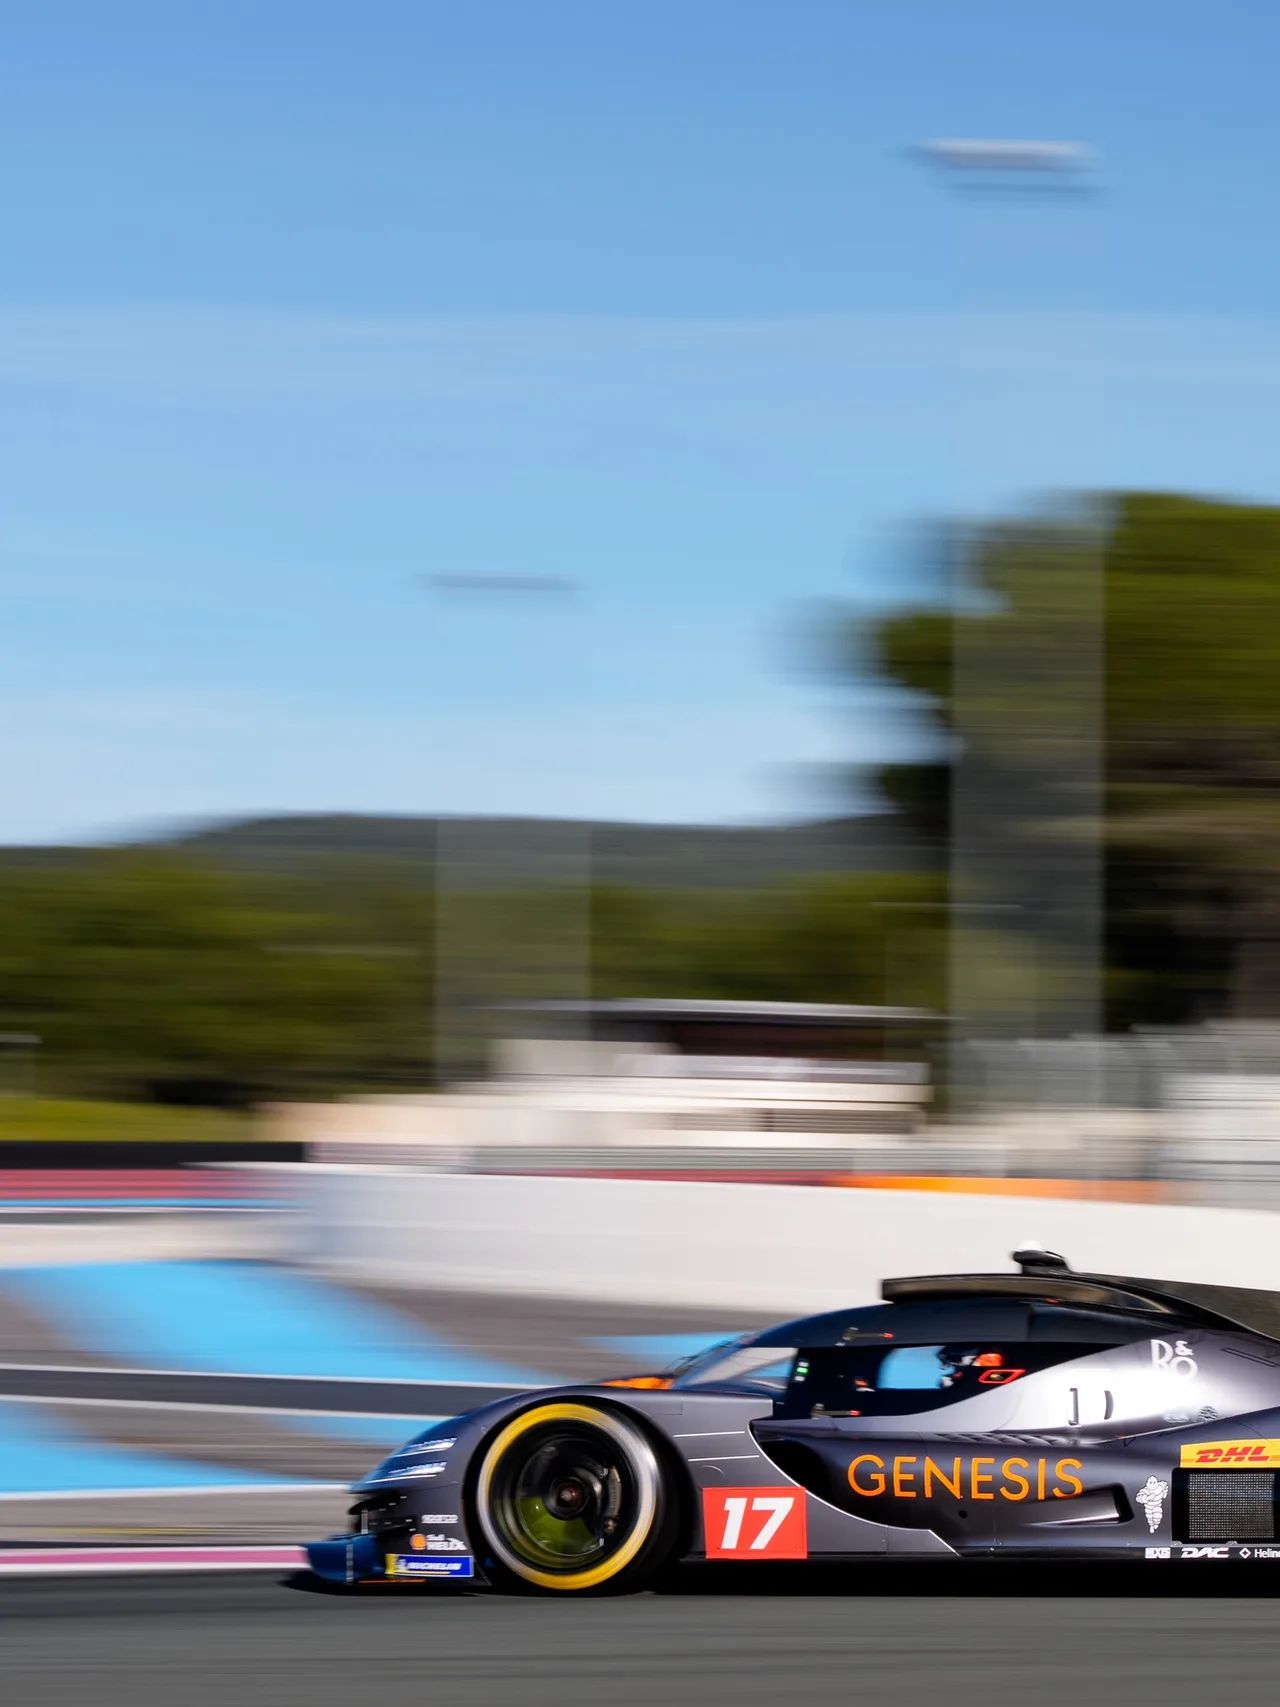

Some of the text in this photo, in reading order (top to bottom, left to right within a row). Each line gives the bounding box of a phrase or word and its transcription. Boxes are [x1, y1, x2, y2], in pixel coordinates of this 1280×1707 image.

[1195, 1446, 1270, 1463] DHL
[847, 1454, 1084, 1501] GENESIS
[721, 1497, 794, 1549] 17
[1180, 1547, 1230, 1558] DAC
